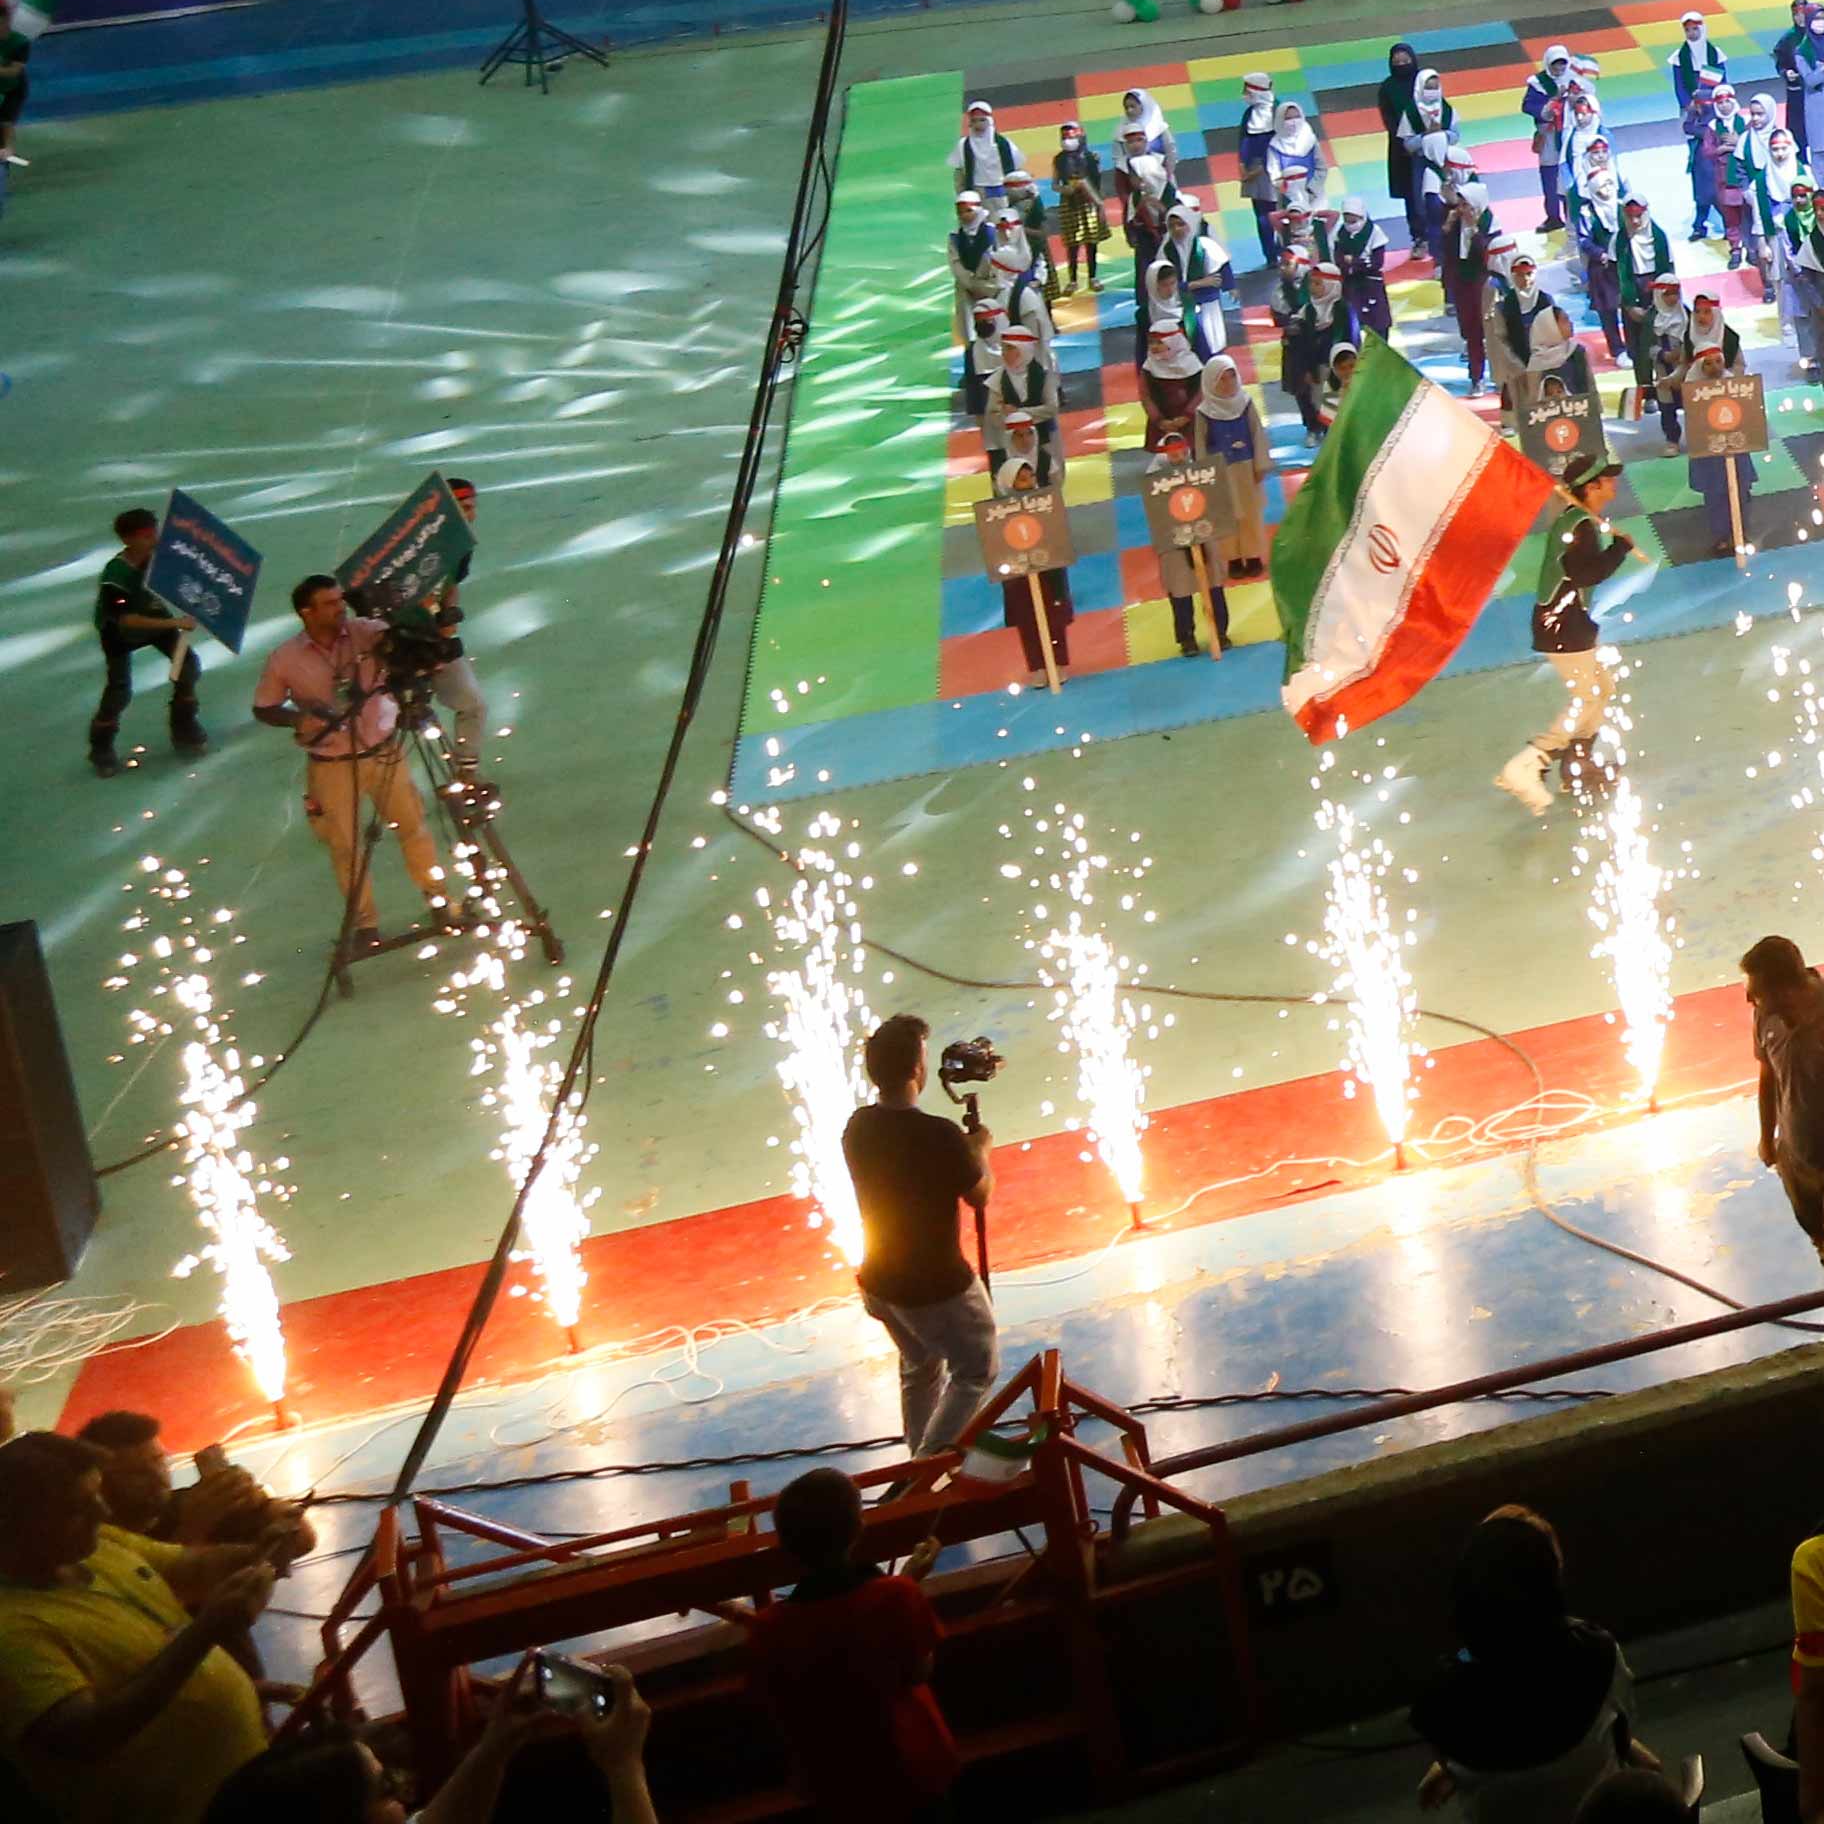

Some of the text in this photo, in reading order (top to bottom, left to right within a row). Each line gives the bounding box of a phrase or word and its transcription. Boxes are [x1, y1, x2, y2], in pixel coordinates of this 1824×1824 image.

[1692, 379, 1755, 402] پویا شهر
[1527, 397, 1589, 426] پویا شهر
[1718, 406, 1733, 424] ۵
[1556, 424, 1567, 443] ۴
[1150, 465, 1216, 496] پویا شهر
[984, 493, 1054, 523] پویا شهر
[1181, 492, 1194, 513] ۲
[1018, 523, 1029, 542] ۱
[1257, 1567, 1326, 1607] ۲۵
